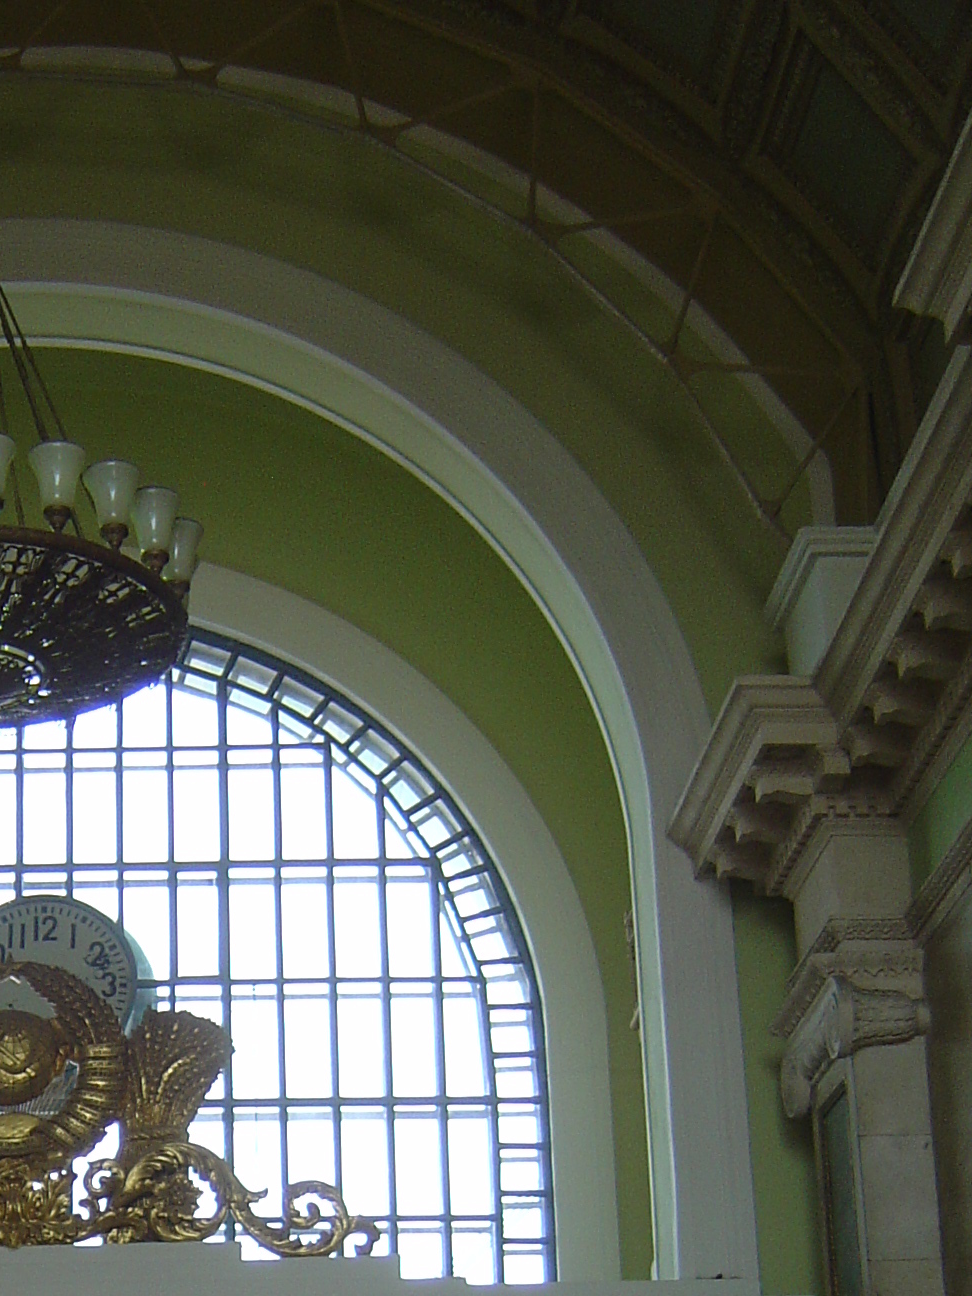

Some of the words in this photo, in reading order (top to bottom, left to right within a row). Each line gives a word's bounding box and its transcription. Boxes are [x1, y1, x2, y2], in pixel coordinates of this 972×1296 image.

[8, 923, 26, 949] 11
[34, 915, 58, 942] 12
[70, 922, 76, 949] 1
[100, 971, 118, 998] 3
